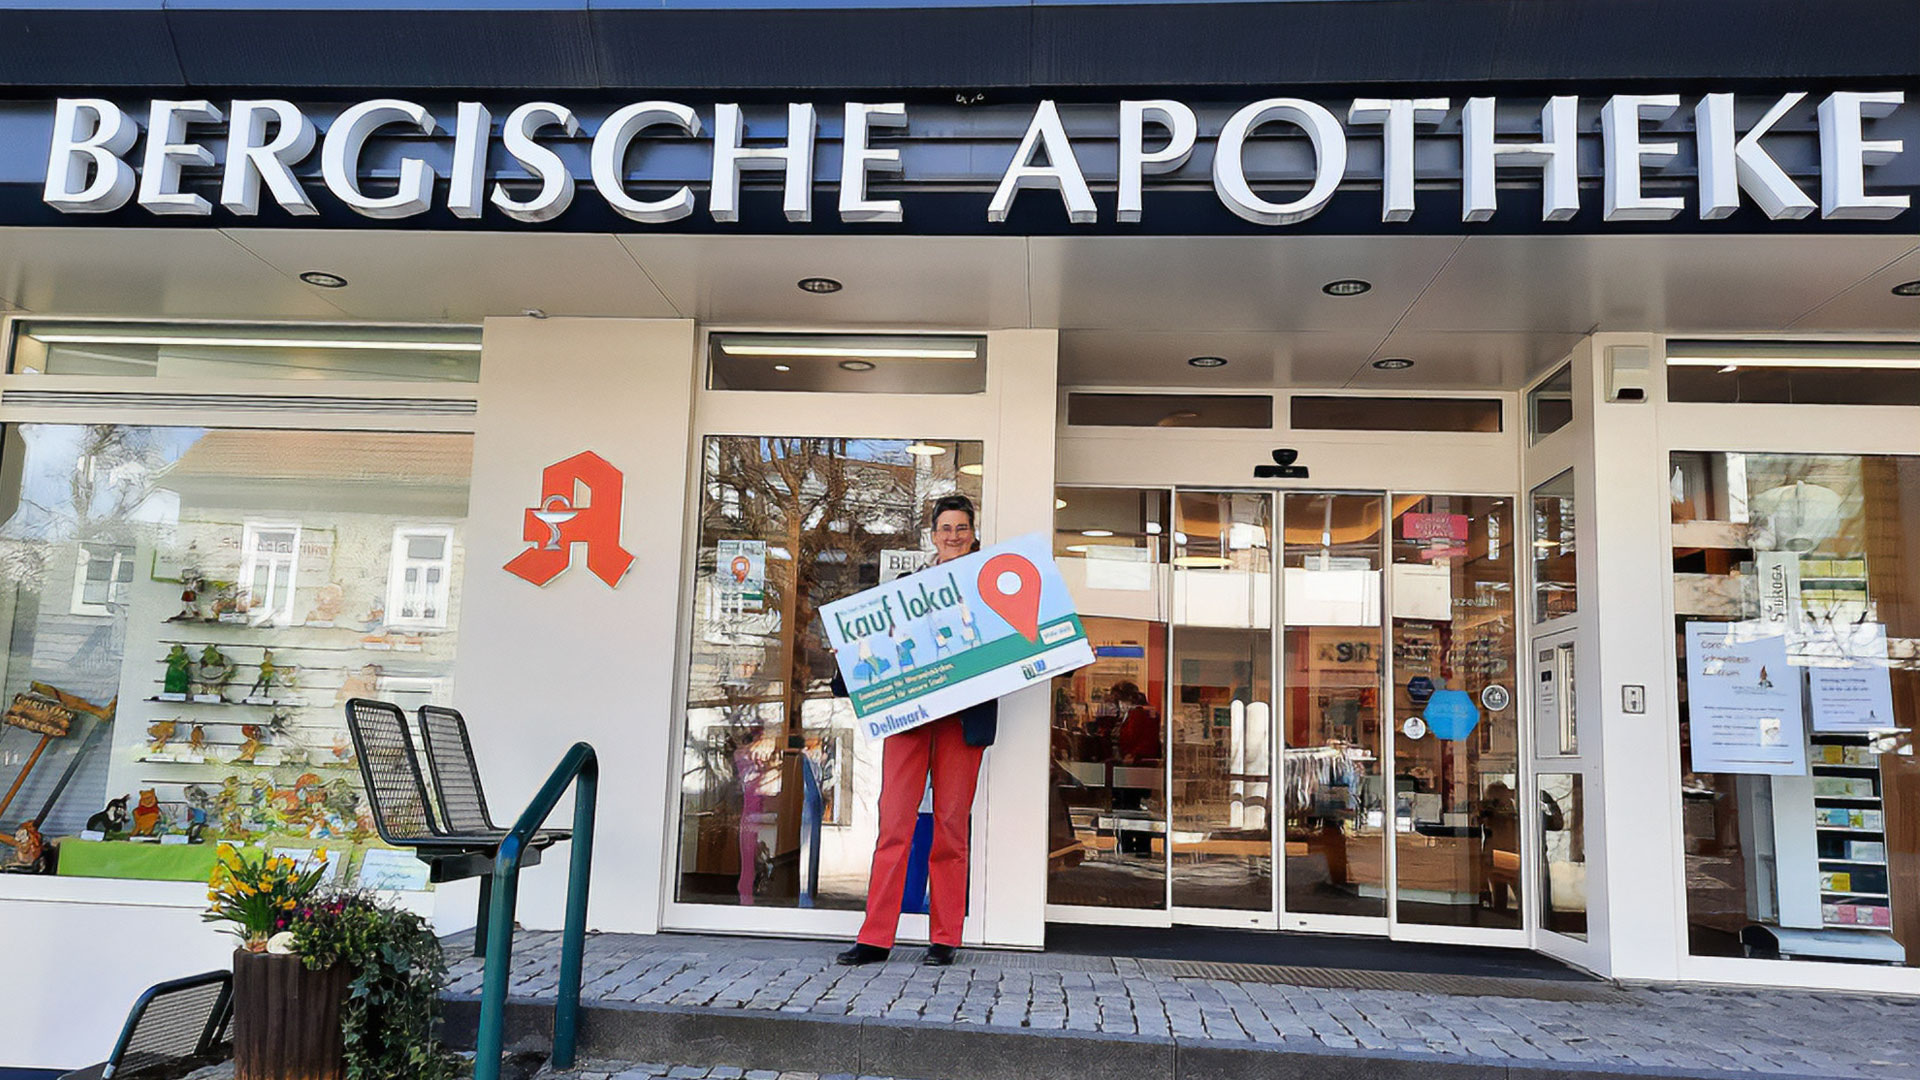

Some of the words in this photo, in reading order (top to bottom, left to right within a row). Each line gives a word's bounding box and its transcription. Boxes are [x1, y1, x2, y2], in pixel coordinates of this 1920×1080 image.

[43, 97, 907, 223] BERGISCHE
[987, 90, 1911, 225] APOTHEKE
[835, 595, 893, 643] kauf
[897, 572, 961, 621] lokal
[869, 704, 929, 737] Dellmark
